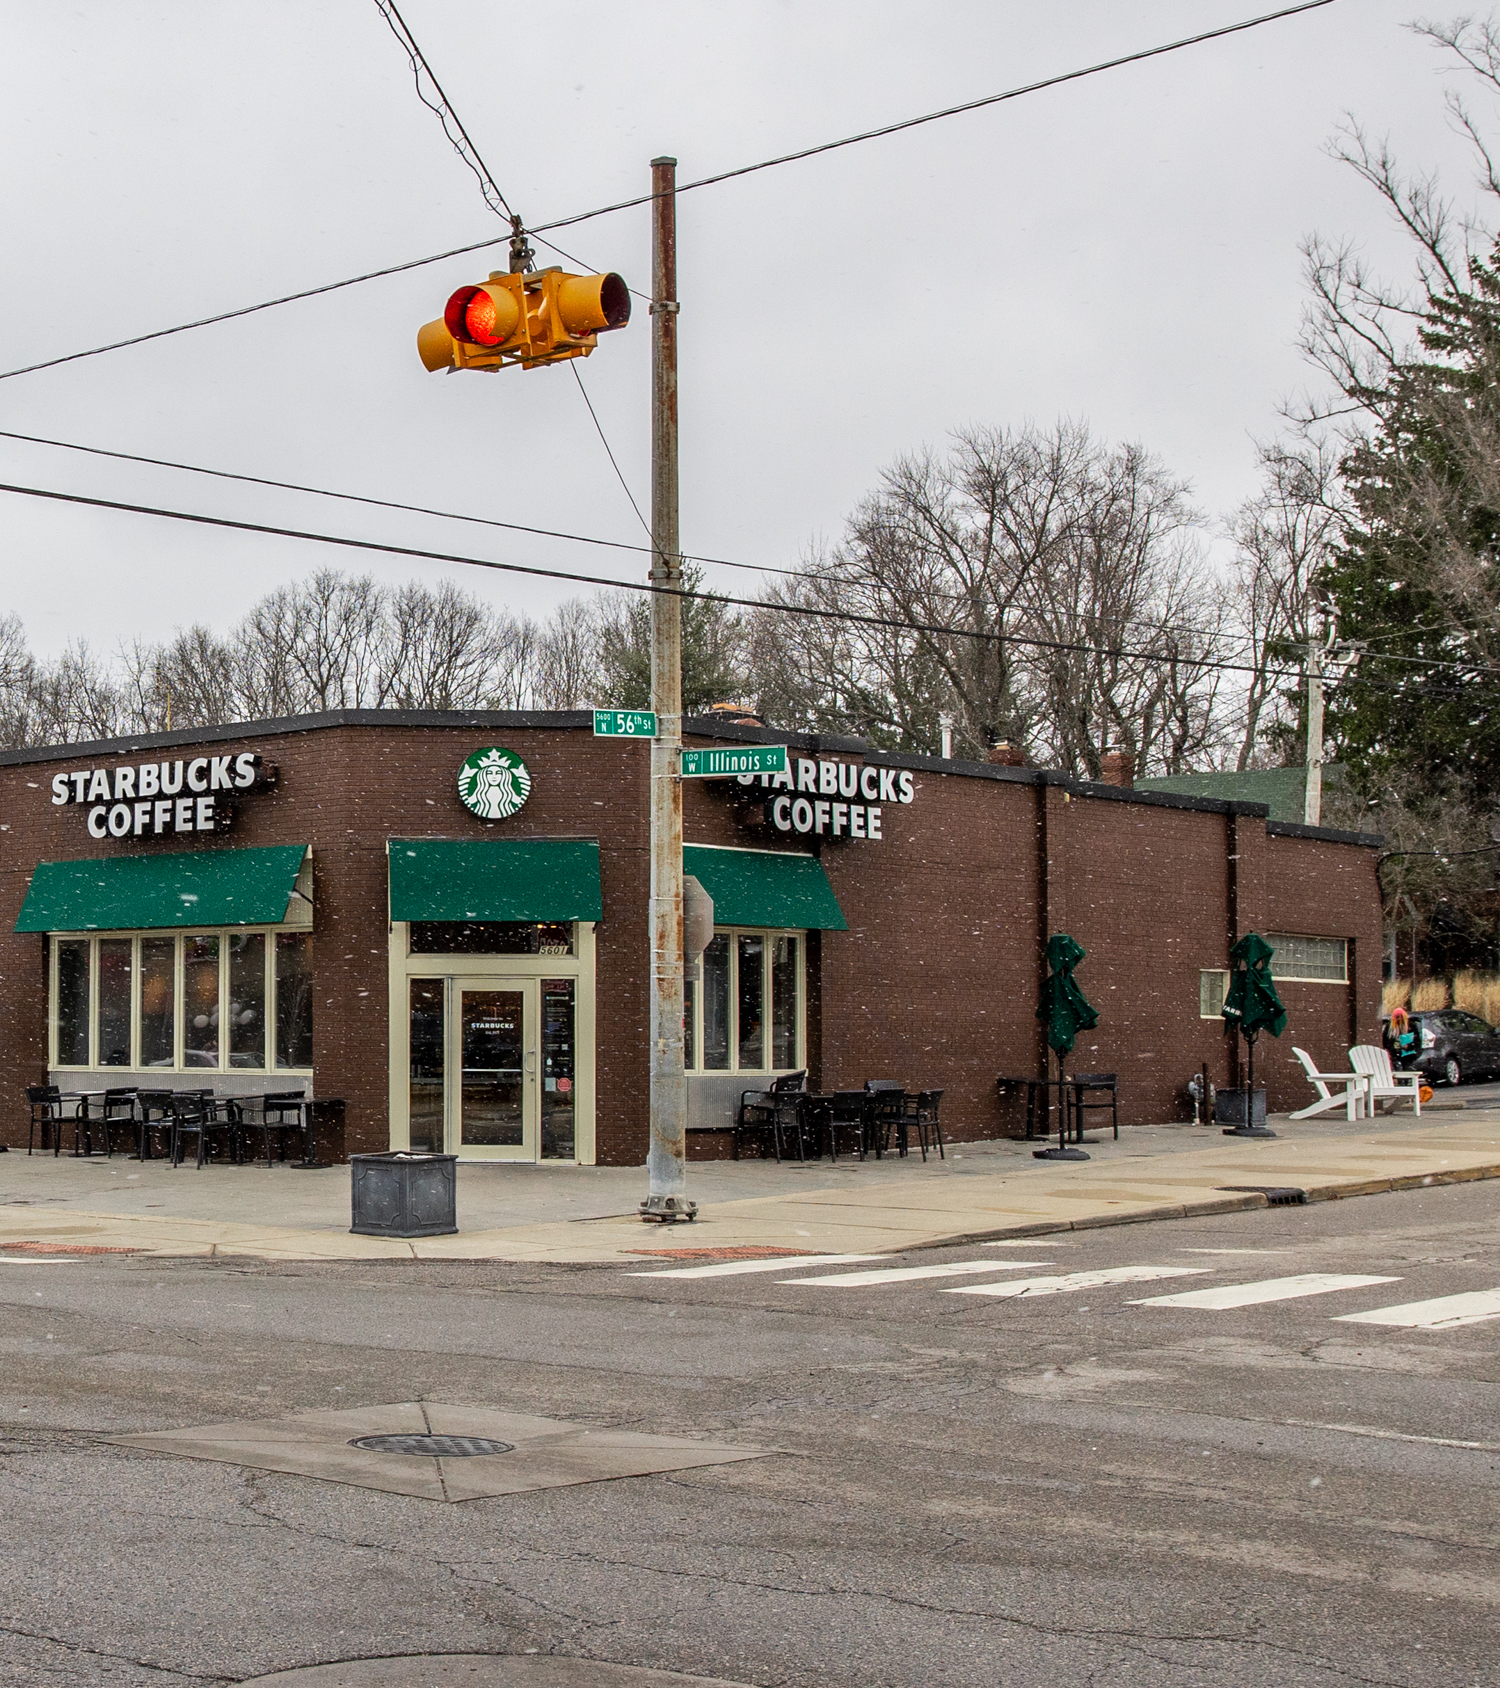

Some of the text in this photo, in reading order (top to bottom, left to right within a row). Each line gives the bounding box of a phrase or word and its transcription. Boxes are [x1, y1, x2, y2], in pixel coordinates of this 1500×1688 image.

[601, 714, 651, 733] N 56th St
[685, 753, 698, 761] 100
[688, 751, 777, 772] W Illinois St
[51, 752, 256, 805] STARBUCKS
[87, 796, 215, 838] COFFEE
[773, 795, 882, 840] COFFEE
[540, 946, 565, 954] 5601
